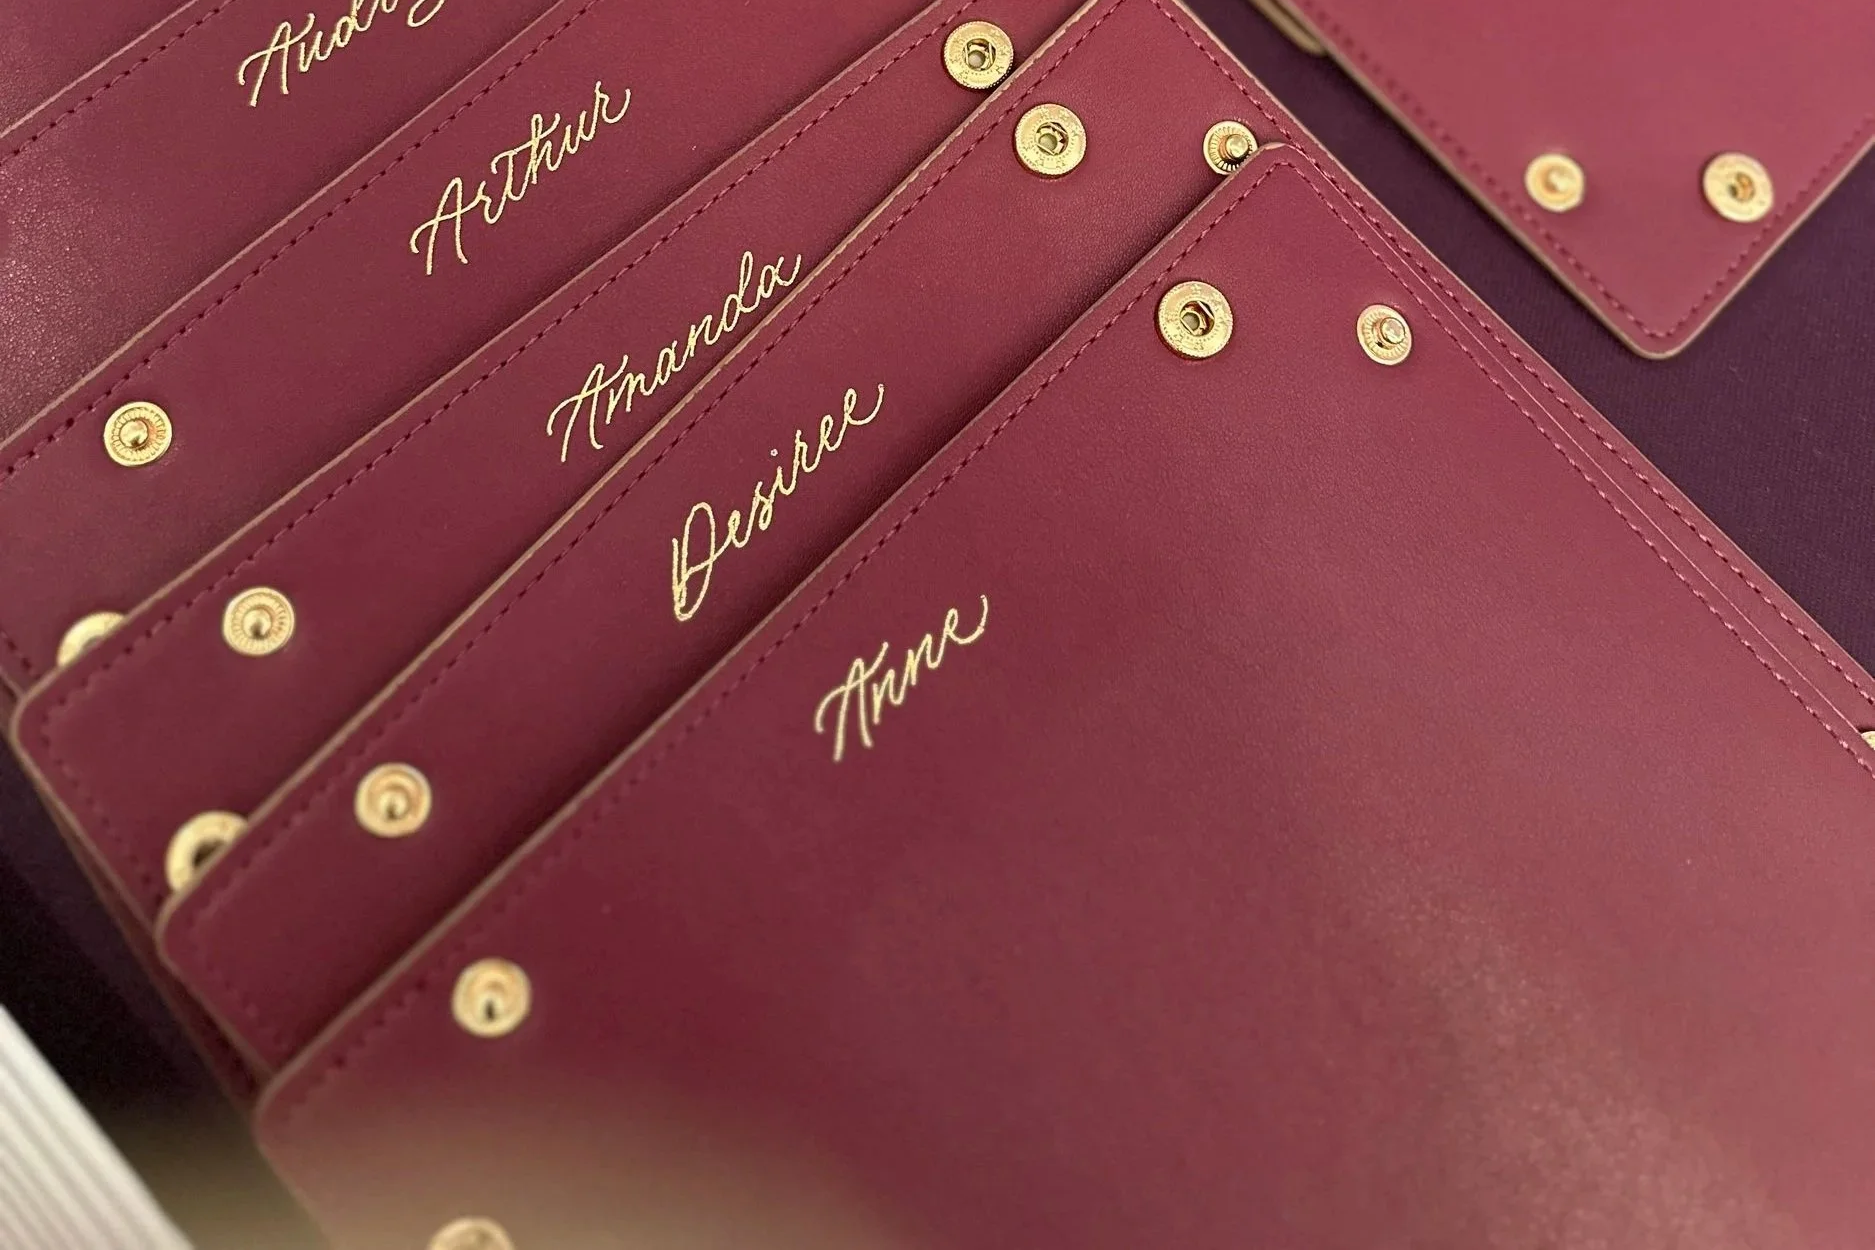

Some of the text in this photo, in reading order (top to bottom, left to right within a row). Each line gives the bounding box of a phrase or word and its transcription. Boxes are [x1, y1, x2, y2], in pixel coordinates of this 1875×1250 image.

[409, 79, 633, 276] Arthur
[546, 250, 802, 463] Amanda
[671, 383, 885, 623] Desiree
[814, 594, 989, 762] Anne
